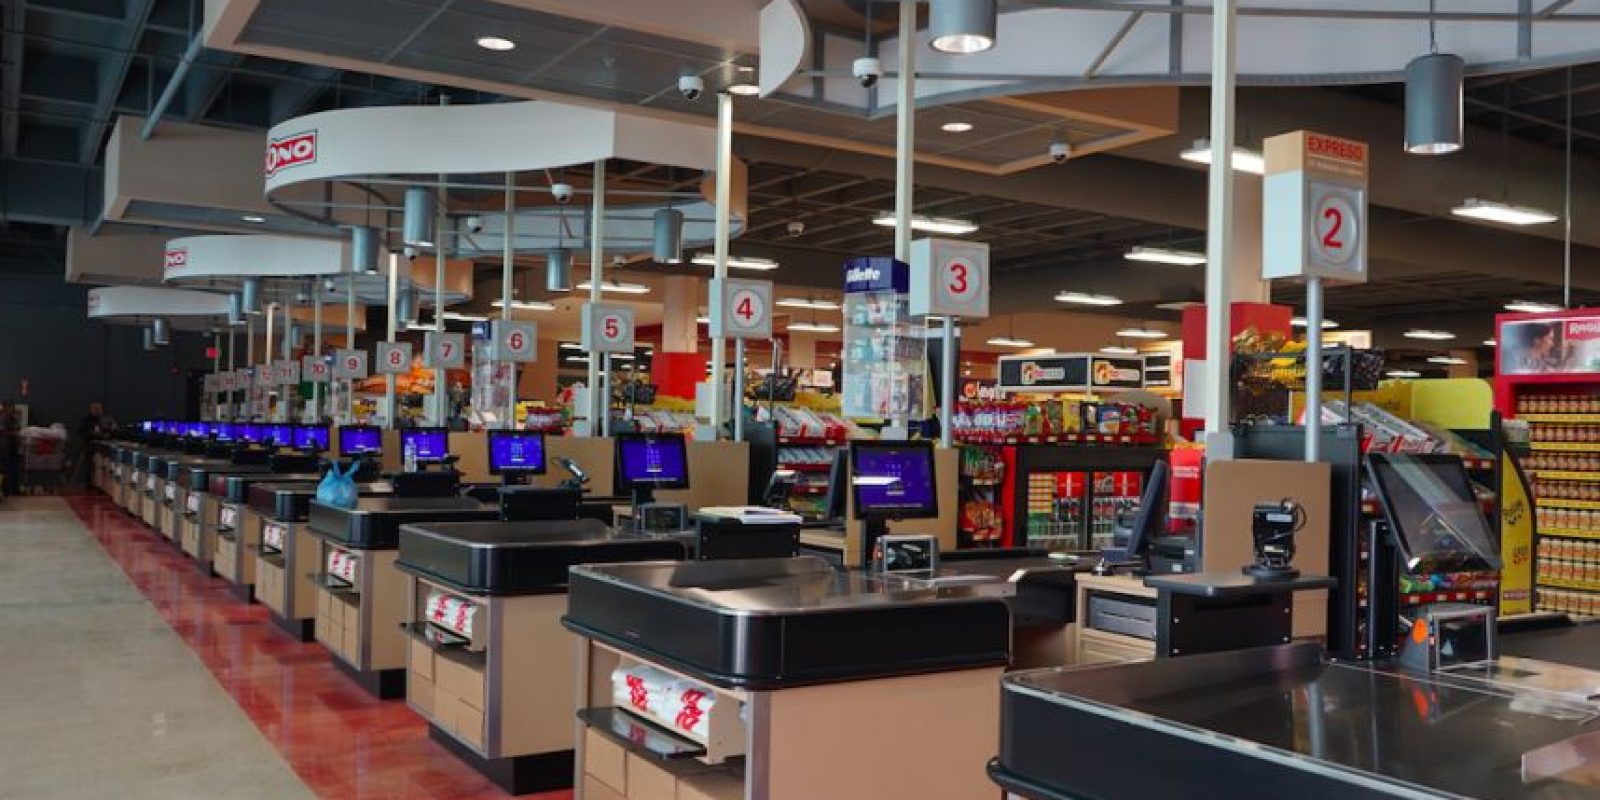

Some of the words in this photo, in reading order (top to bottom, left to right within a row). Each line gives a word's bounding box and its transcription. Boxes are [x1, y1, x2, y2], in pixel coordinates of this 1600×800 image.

[1308, 136, 1363, 160] EXPRESO
[1323, 207, 1343, 249] 2
[949, 264, 967, 294] 3
[736, 298, 753, 319] 4
[603, 318, 618, 338] 5
[440, 343, 452, 356] 7
[510, 333, 523, 349] 6
[347, 358, 358, 370] 9
[389, 351, 401, 365] 8
